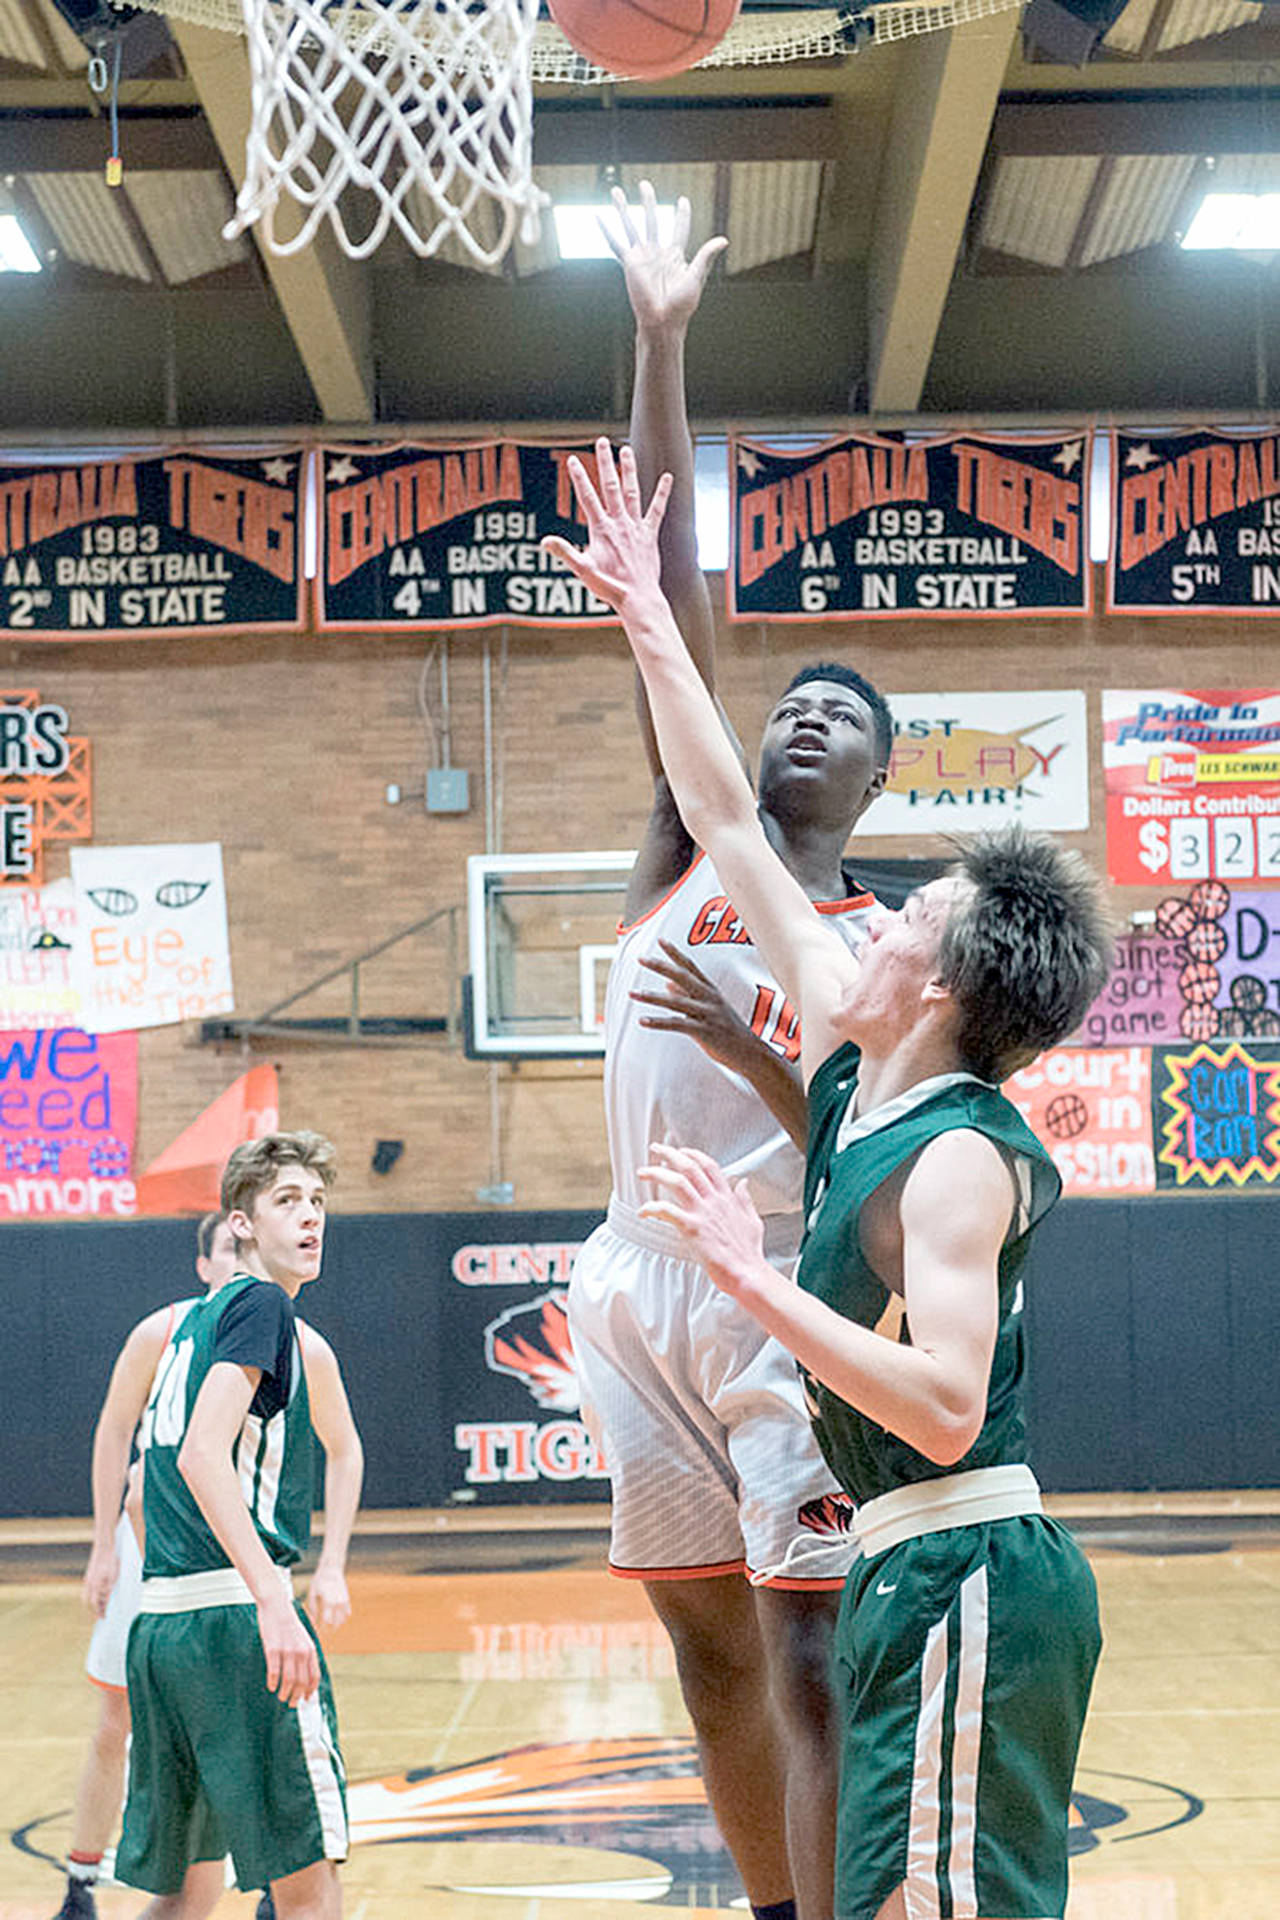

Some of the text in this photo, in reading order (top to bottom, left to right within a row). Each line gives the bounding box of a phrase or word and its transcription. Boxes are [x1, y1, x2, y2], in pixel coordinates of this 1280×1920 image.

[164, 459, 294, 583] TIGERS
[328, 444, 523, 586] CENTRALIA
[473, 511, 536, 542] 1991
[739, 447, 929, 588] CENTRALIA
[952, 443, 1080, 577] TIGERS
[866, 508, 945, 537] 1993
[82, 524, 160, 555] 1983
[801, 537, 1029, 569] AA BASKETBALL
[1185, 528, 1219, 557] AA
[3, 553, 233, 586] AA BASKETBALL
[388, 547, 426, 577] AA
[452, 577, 487, 616] IN
[862, 572, 898, 609] IN
[915, 572, 1018, 609] STATE
[1171, 563, 1221, 602] 5TH
[69, 589, 105, 627] IN
[119, 585, 227, 626] STATE
[1133, 702, 1220, 730] Pride
[890, 743, 1068, 779] PLAY
[908, 782, 1023, 811] FAIR!
[1123, 796, 1192, 817] Dollars
[90, 926, 184, 981] Eye
[177, 955, 215, 985] of
[1108, 970, 1164, 1007] got
[1087, 1012, 1167, 1048] game
[1100, 1096, 1142, 1128] in
